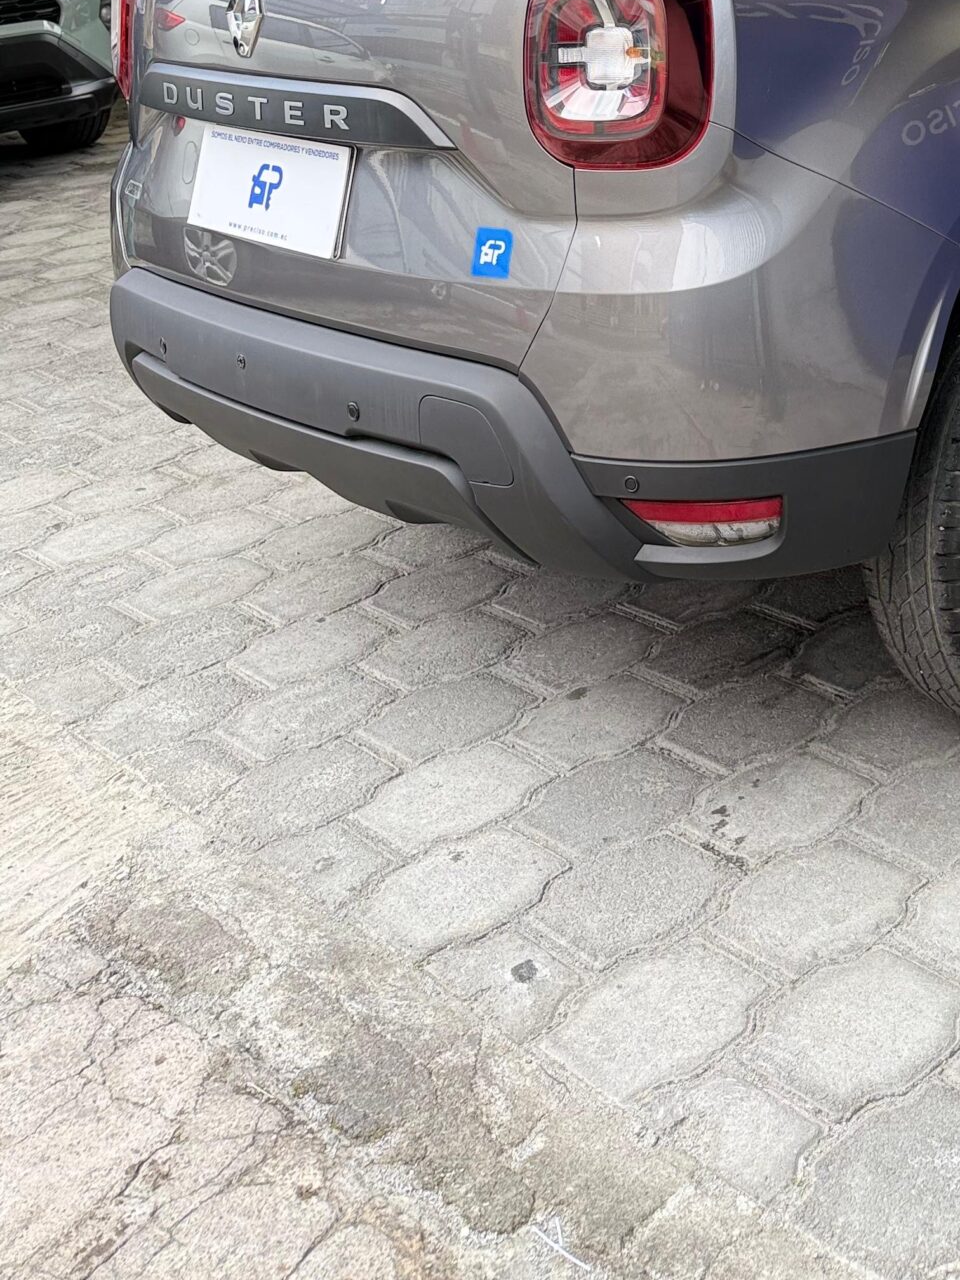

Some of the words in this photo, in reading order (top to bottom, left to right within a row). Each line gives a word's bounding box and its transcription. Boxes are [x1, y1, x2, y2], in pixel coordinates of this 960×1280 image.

[162, 82, 350, 131] DUSTER
[211, 130, 228, 141] SOMOS
[234, 135, 247, 144] NEXO
[247, 137, 263, 147] ENTRE
[263, 140, 300, 154] COMPRADORES
[305, 147, 339, 161] VENDEDORES
[228, 221, 288, 242] www.preciso.com.ec
